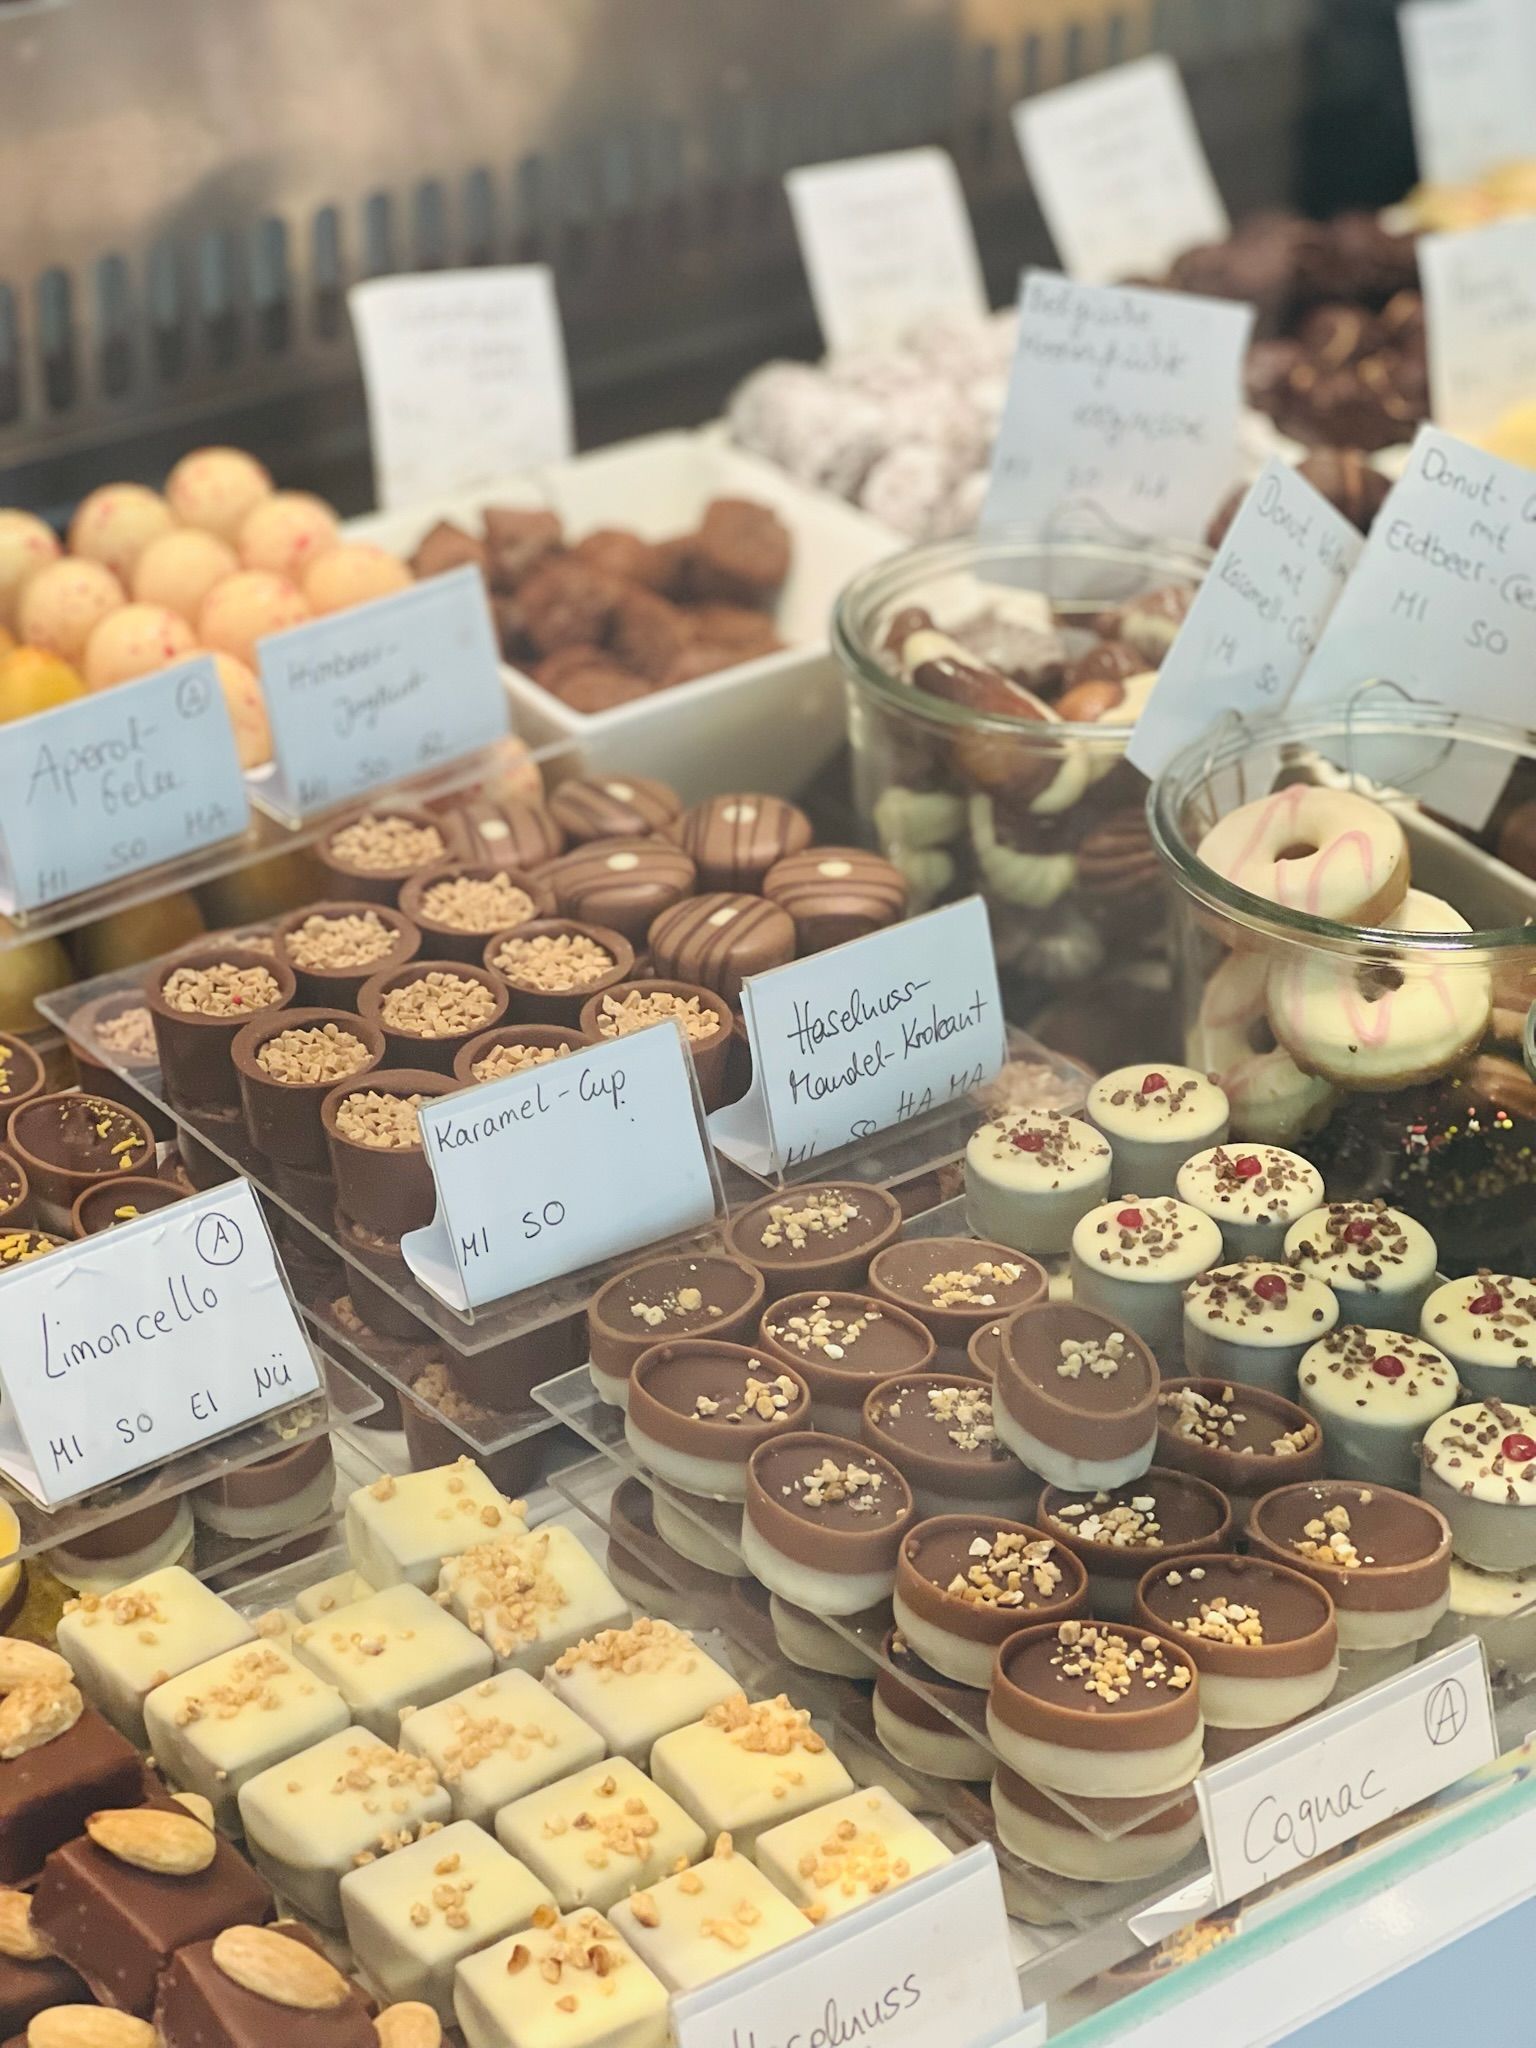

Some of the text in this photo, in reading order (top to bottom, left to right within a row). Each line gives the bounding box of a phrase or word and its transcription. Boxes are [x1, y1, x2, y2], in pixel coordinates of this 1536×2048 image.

[1392, 589, 1510, 655] MI SO
[106, 836, 148, 871] SO
[896, 1086, 936, 1124] HA
[460, 1200, 566, 1266] MI SO
[42, 1273, 218, 1379] Limoncello
[49, 1352, 292, 1473] MI SO EI NÜ
[1243, 1769, 1387, 1864] Cognac
[732, 1973, 922, 2048] elnuss
